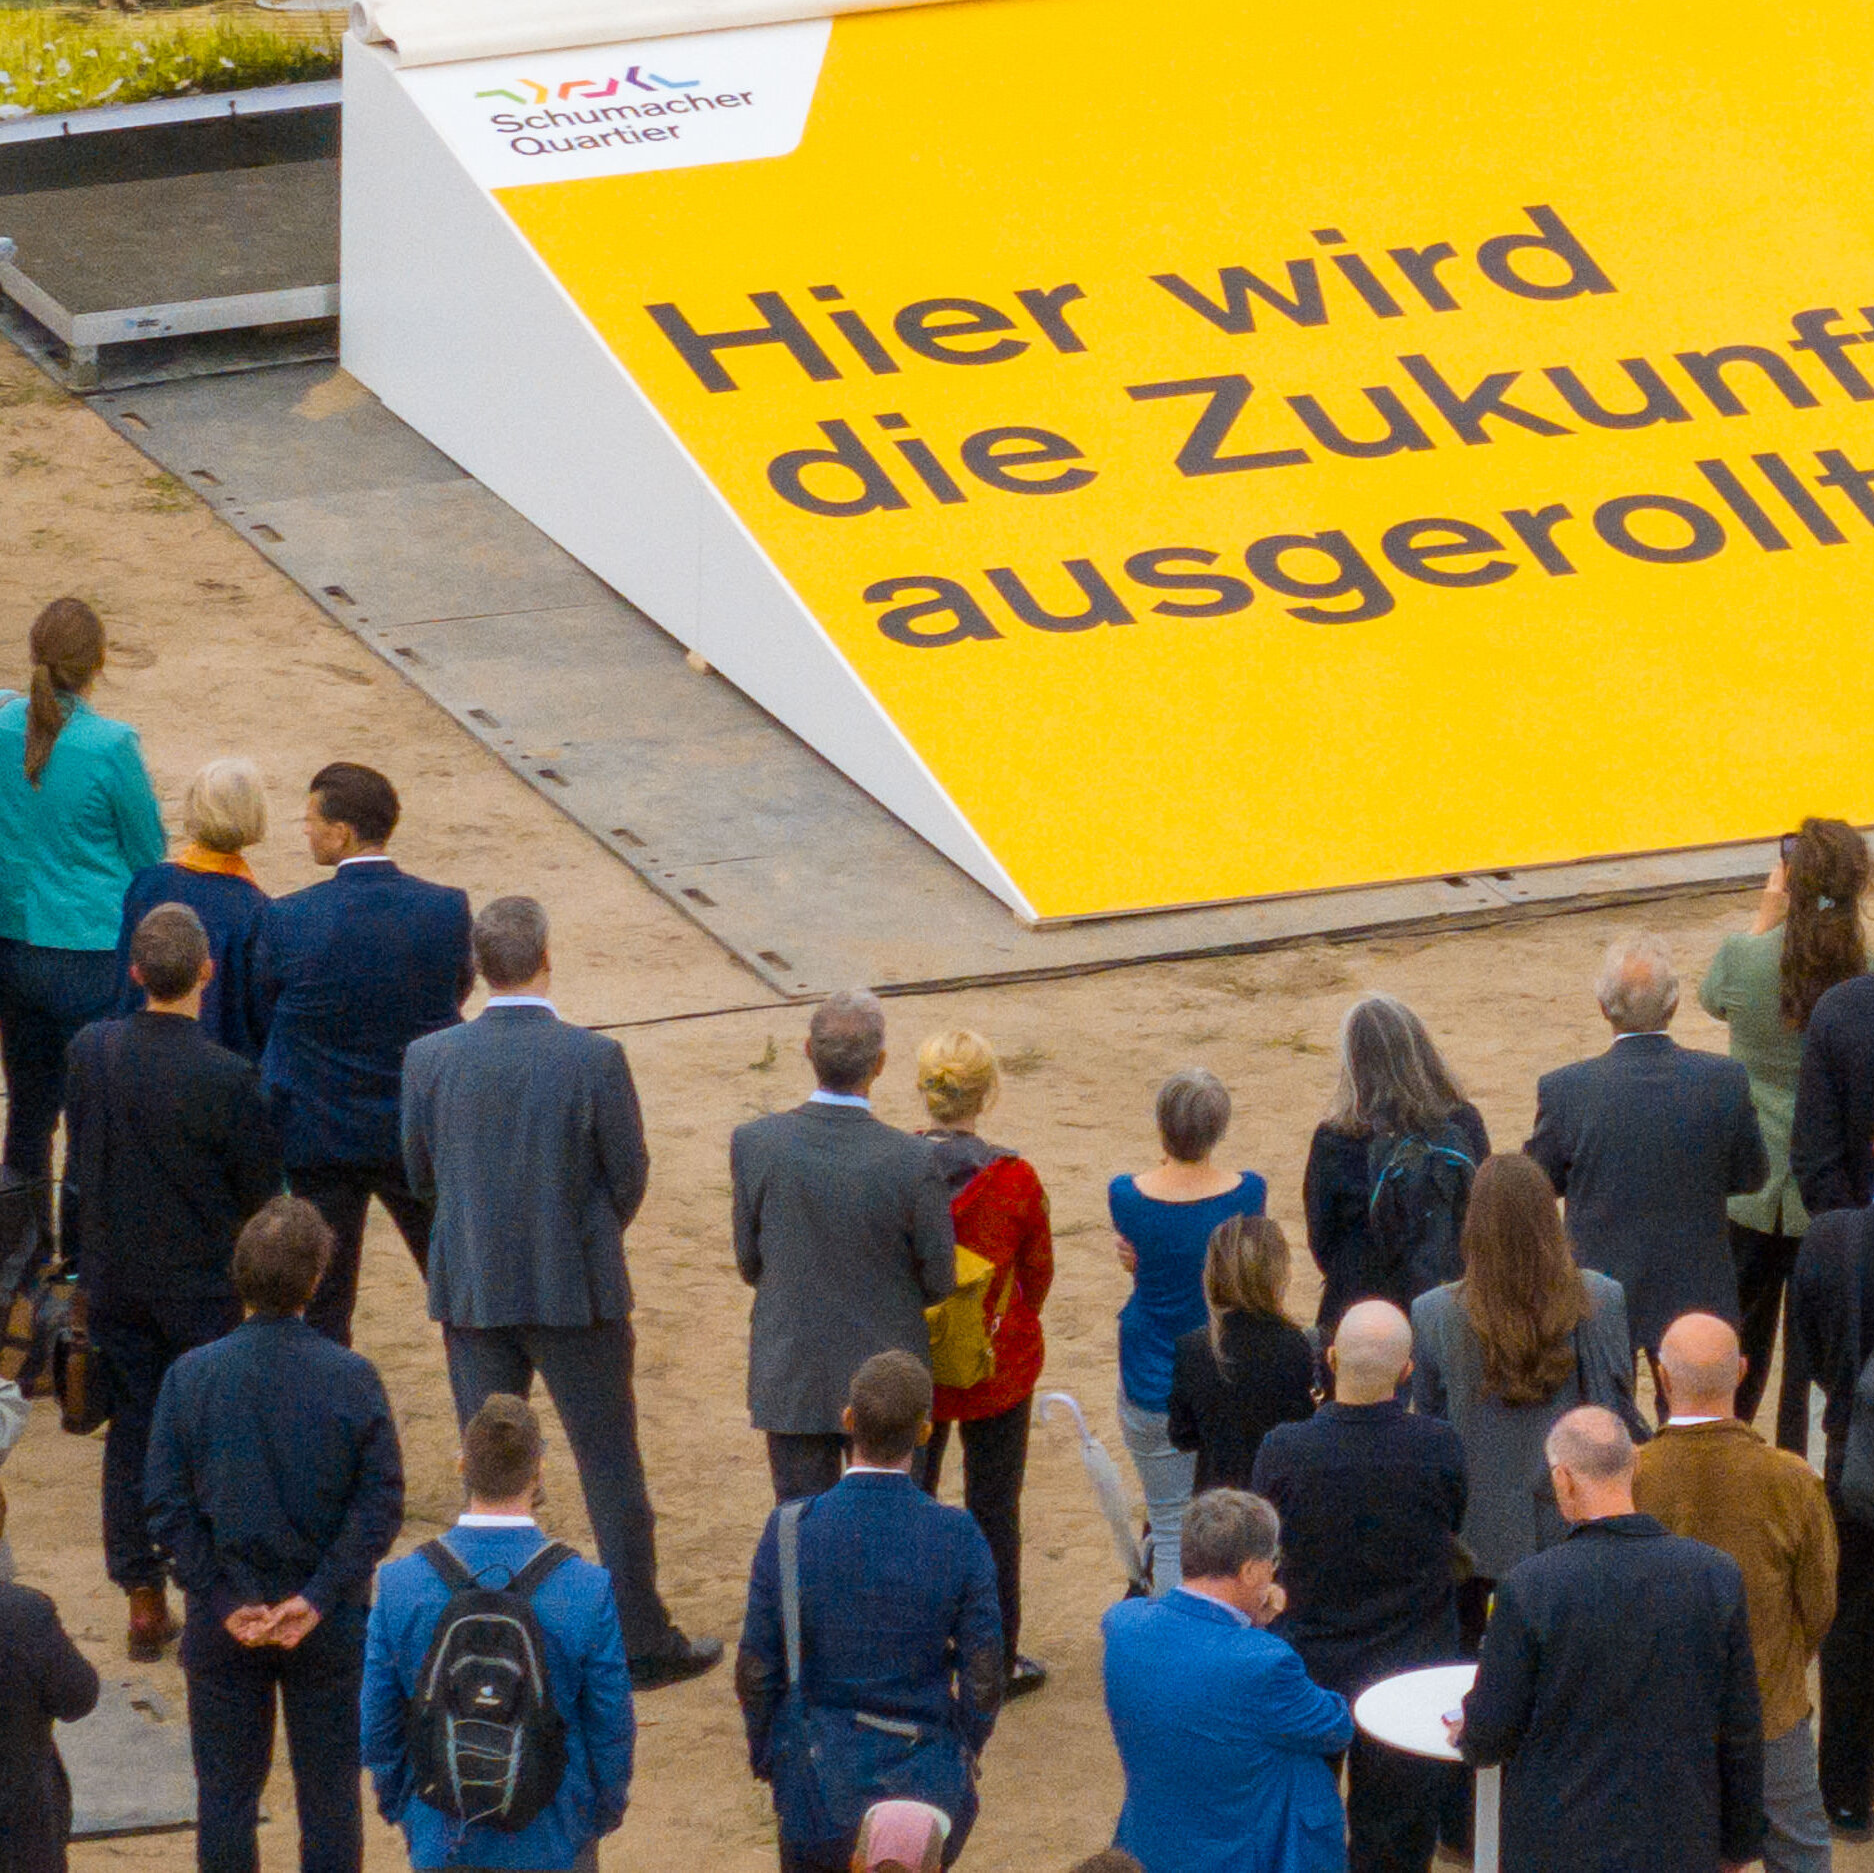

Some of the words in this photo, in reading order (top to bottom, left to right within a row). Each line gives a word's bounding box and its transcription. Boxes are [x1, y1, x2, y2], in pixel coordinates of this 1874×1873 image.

[490, 90, 754, 133] Schumacher
[510, 124, 680, 156] Quartier
[645, 283, 1088, 394] Hier
[1150, 204, 1618, 335] wird
[766, 413, 1098, 518] die
